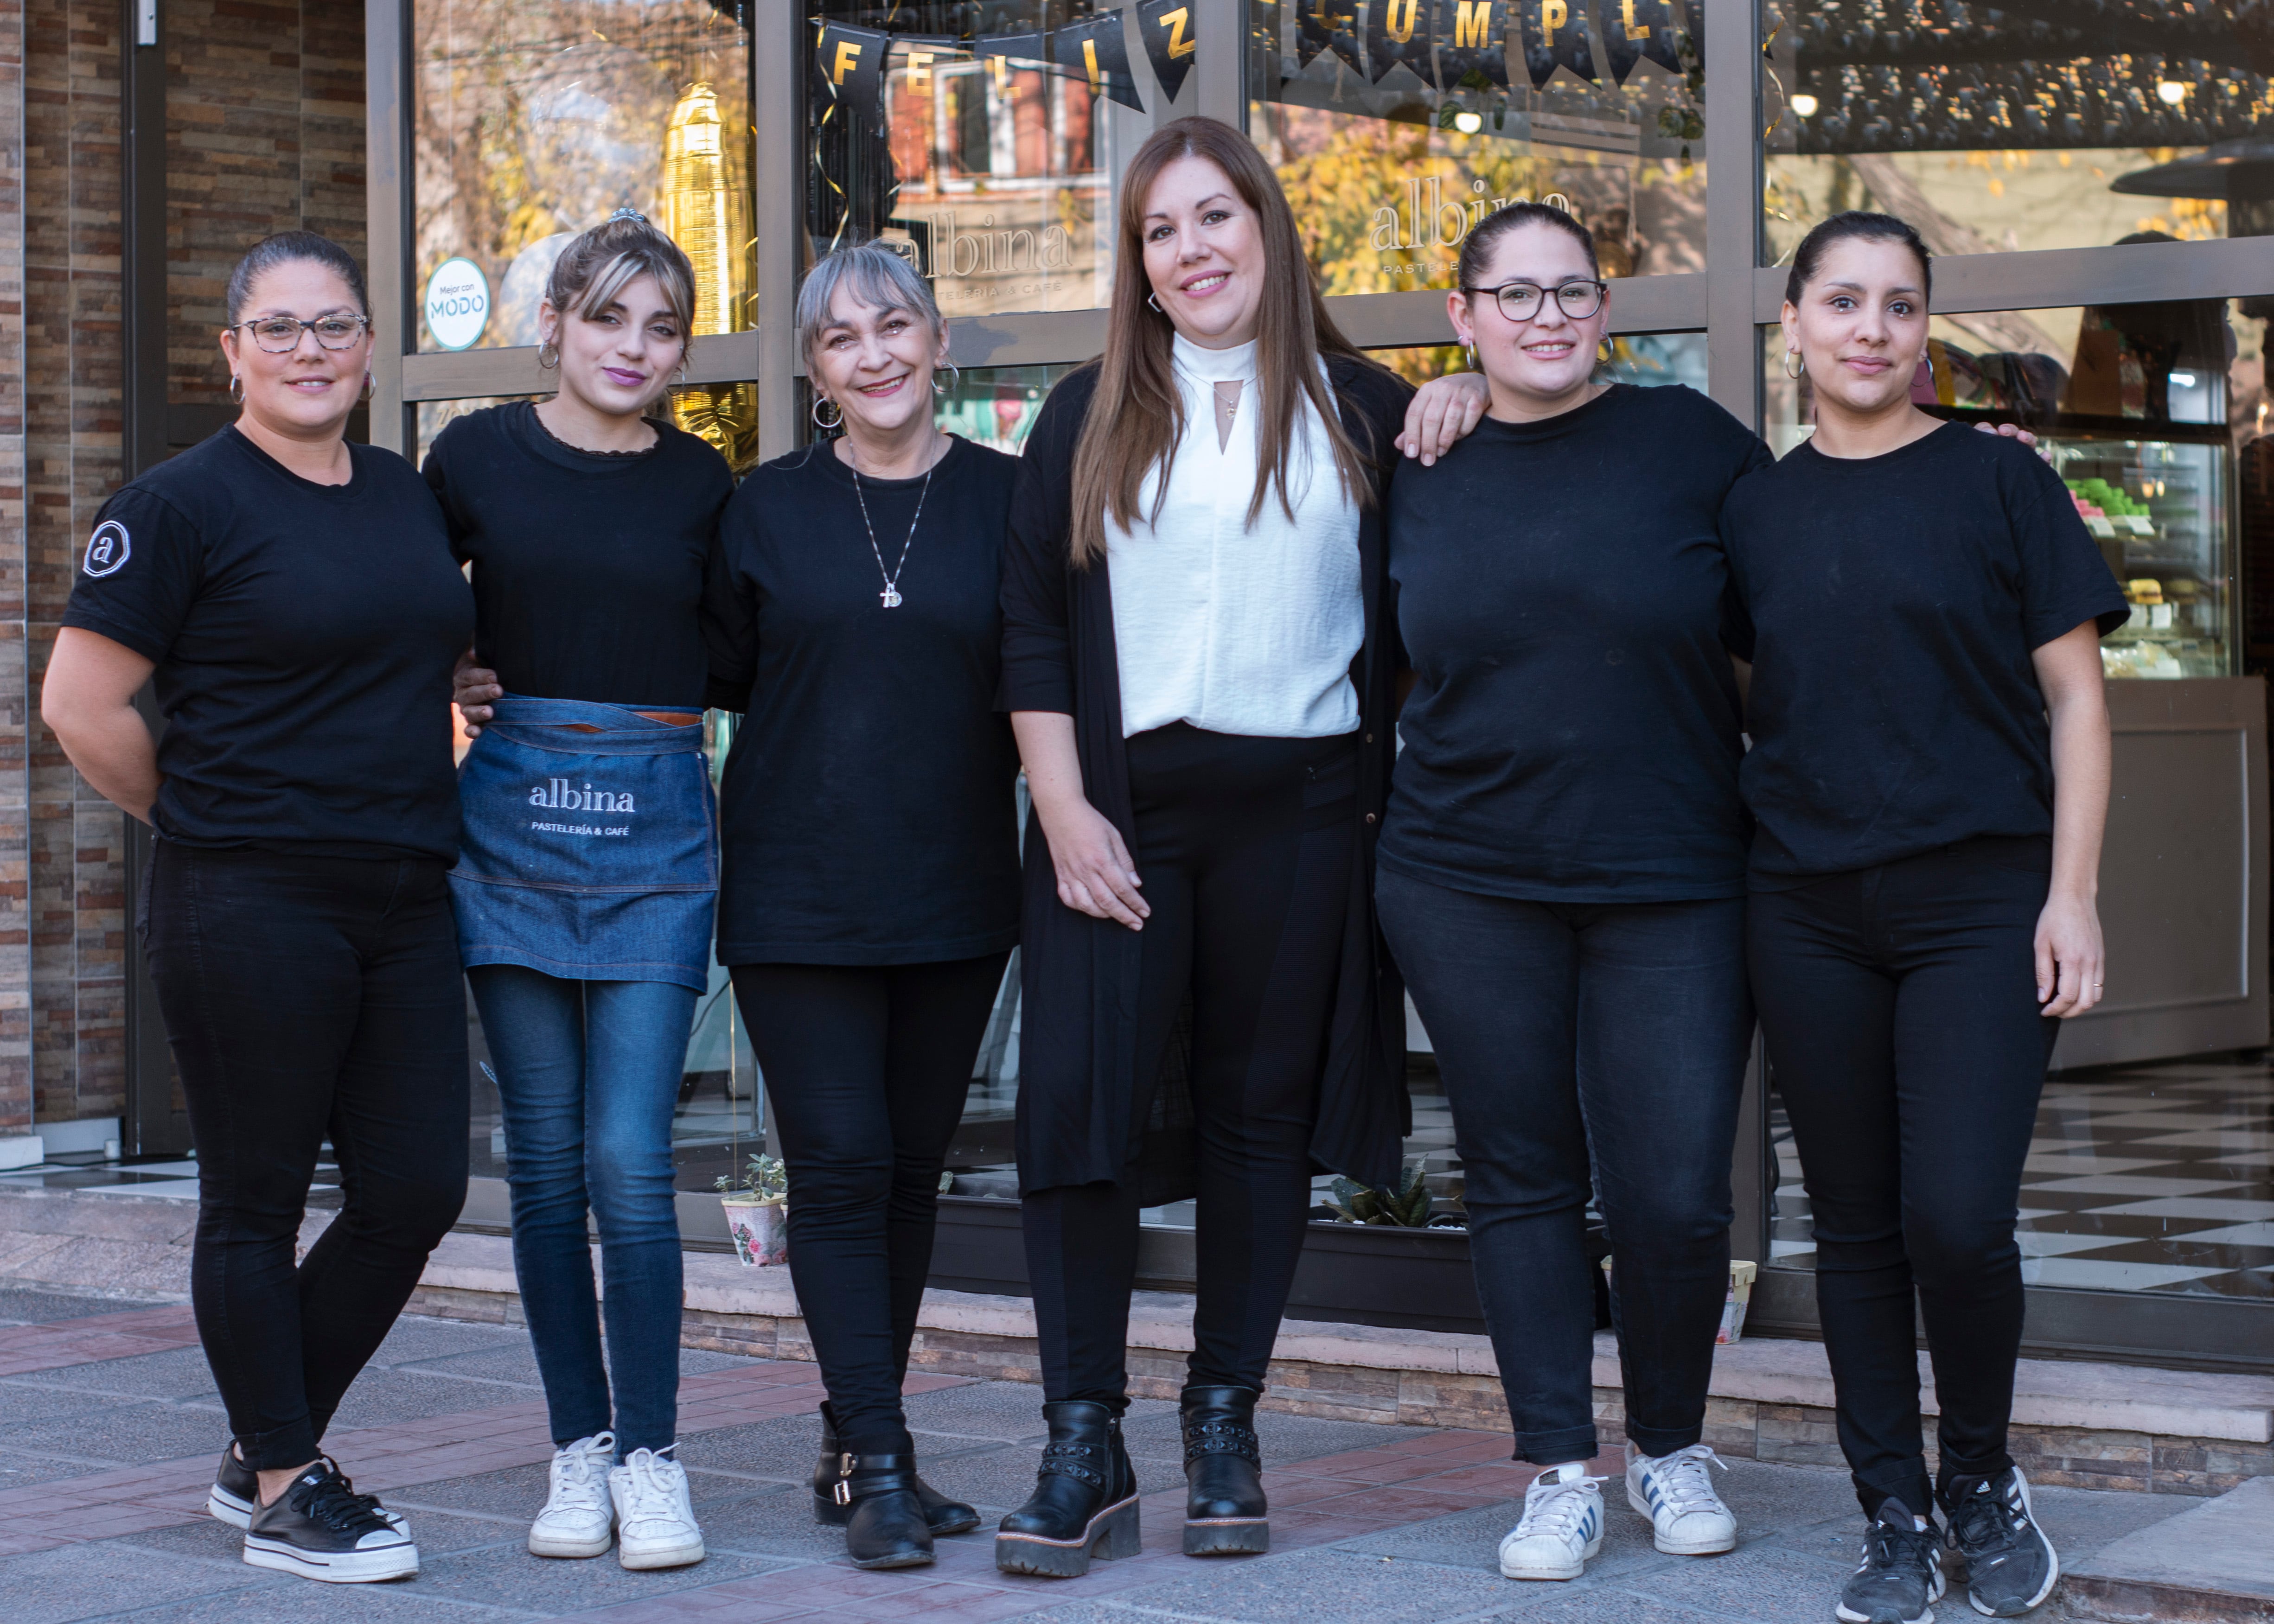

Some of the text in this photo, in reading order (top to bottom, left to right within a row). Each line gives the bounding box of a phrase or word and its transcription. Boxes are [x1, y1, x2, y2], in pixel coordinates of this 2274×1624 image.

[834, 0, 1650, 99] FELIZ CUMPL
[1369, 176, 1570, 251] albi
[1383, 261, 1458, 274] PASTELE
[440, 286, 459, 295] Mejor
[937, 286, 1000, 300] TELERÍA
[1022, 280, 1062, 293] CAFÉ
[431, 294, 484, 318] MODO
[92, 537, 114, 563] a
[529, 778, 636, 812] albina
[531, 822, 592, 835] PASTELERÍA
[605, 826, 630, 835] CAFÉ
